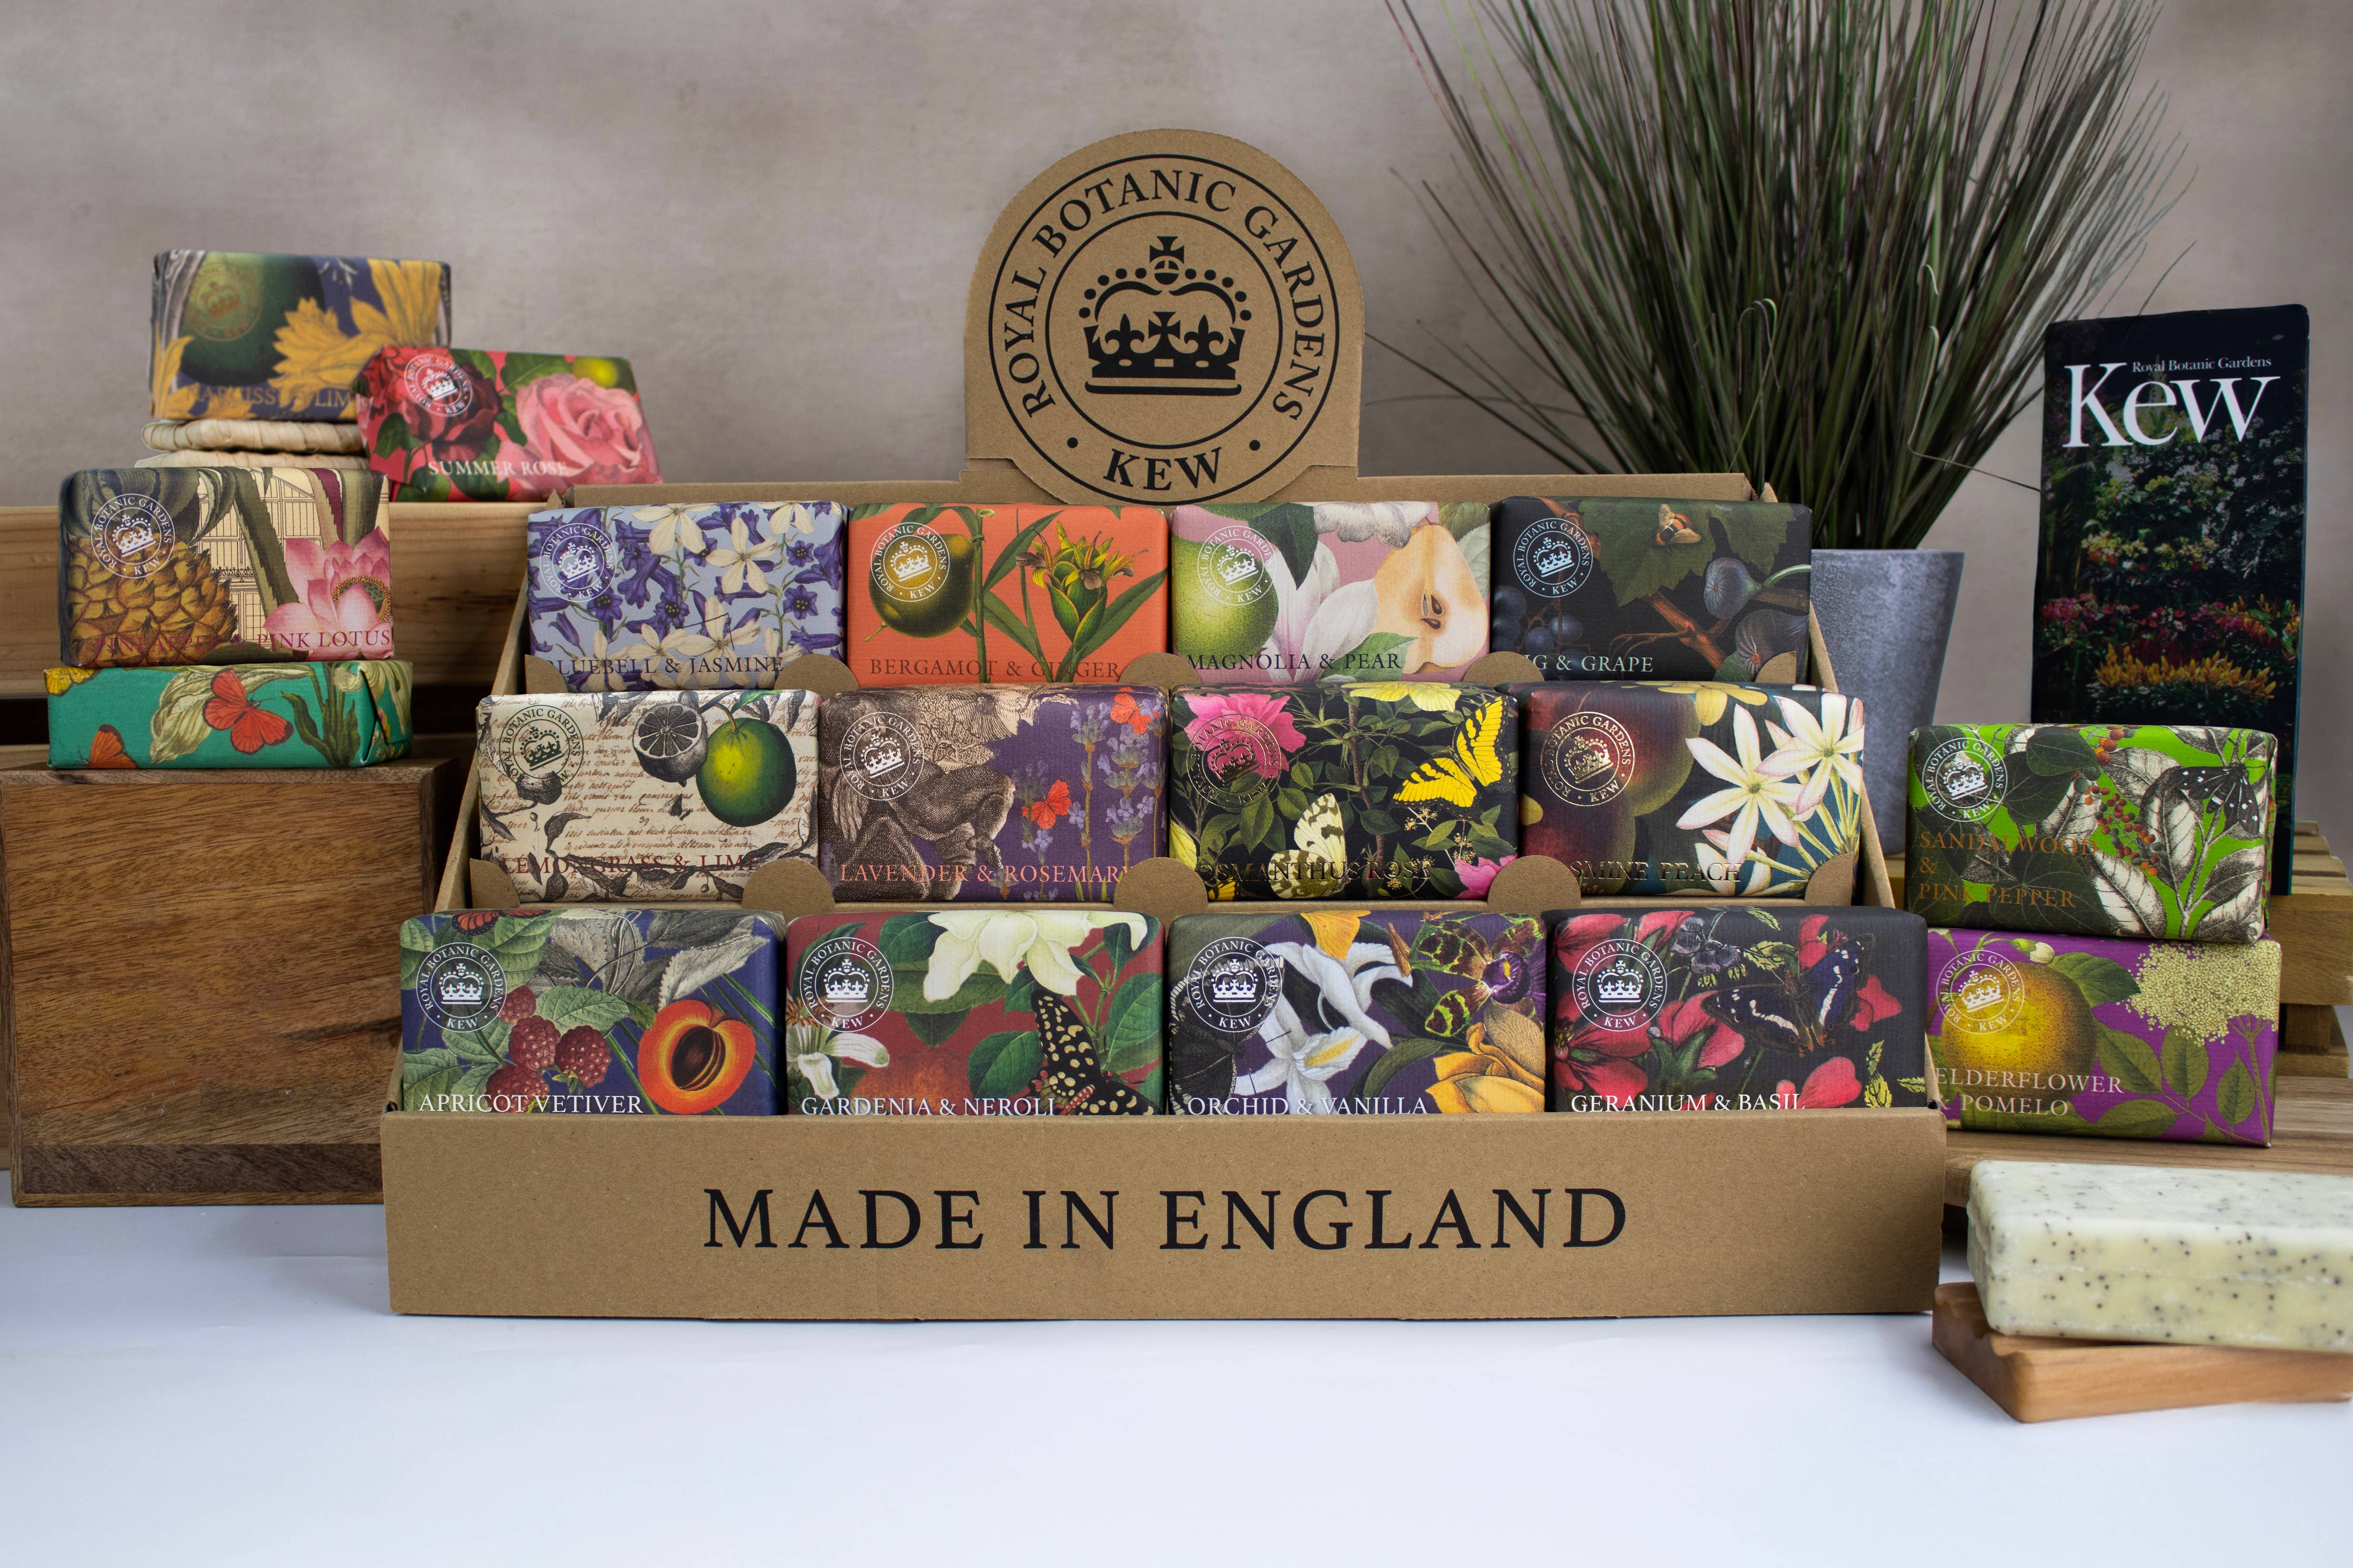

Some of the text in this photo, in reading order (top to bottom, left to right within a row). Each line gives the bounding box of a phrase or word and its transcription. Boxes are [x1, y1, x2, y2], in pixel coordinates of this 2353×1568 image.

[1004, 169, 1325, 421] ROYAL BOTANIC GARDENS
[2132, 356, 2272, 376] Royal Botanic Gardens
[314, 390, 356, 407] LIM
[2062, 361, 2281, 448] Kew
[428, 461, 567, 476] SUMMER ROSE
[1102, 446, 1222, 491] KEW
[95, 497, 172, 569] ROYAL BOTANIC GARDENS
[1201, 528, 1240, 561] BOTANIC
[134, 555, 161, 575] KEW
[543, 526, 614, 593] ROYAL BOTANIC GARDENS
[873, 525, 947, 592] ROYAL BOTANIC GARDENS
[1516, 521, 1590, 588] ROYAL BOTANIC GARDENS
[579, 581, 604, 599] KEW
[909, 581, 936, 599] KEW
[1236, 585, 1263, 603] KEW
[1552, 578, 1577, 595] KEW
[94, 630, 390, 654] PINEAPPLE & PINK LOTUS
[547, 656, 785, 675] LUEBELL & JASMINE
[870, 659, 1121, 678] BERGAMOT & GINGER
[1187, 653, 1402, 671] MAGNOLIA & PEAR
[1556, 655, 1573, 671] &
[1581, 655, 1653, 672] GRAPE
[504, 707, 543, 745] BOTANIC
[547, 710, 581, 756] GARDENS
[843, 715, 885, 751] BOTANIC
[888, 717, 921, 765] GARDENS
[1238, 718, 1279, 767] GARDENS
[1545, 715, 1590, 757] BOTANIC
[1592, 716, 1631, 765] GARDENS
[1926, 740, 2005, 811] ROYAL BOTANIC GARDENS
[882, 778, 909, 798] KEW
[1238, 782, 1268, 805] KEW
[1588, 779, 1620, 803] KEW
[1963, 801, 1990, 820] KEW
[1919, 830, 2098, 856] SANDALWOOD
[501, 854, 664, 875] LEMONGRASS
[673, 853, 691, 872] &
[699, 854, 760, 872] LIME
[841, 863, 969, 883] LAVENDER
[977, 864, 994, 882] &
[1197, 860, 1431, 883] OSMANTHUS ROSE
[1569, 860, 1741, 883] SMINE PEACH
[1919, 857, 1936, 874] &
[1918, 883, 2077, 908] PINK PEPPER
[419, 946, 504, 1010] ROYAL BOTANIC GARDENS
[805, 940, 890, 1009] ROYAL BOTANIC GARDENS
[1190, 940, 1279, 1009] ROYAL BOTANIC GARDENS
[1576, 943, 1663, 1010] ROYAL BOTANIC GARDENS
[1940, 953, 1985, 986] BOTANIC
[1987, 955, 2021, 1002] GARDENS
[446, 1017, 478, 1030] KEW
[830, 1016, 862, 1029] KEW
[1219, 1016, 1251, 1029] KEW
[1603, 1016, 1636, 1029] KEW
[1978, 1013, 2007, 1031] KEW
[1936, 1067, 2124, 1094] ELDERFLOWER
[418, 1094, 645, 1115] APRICOT VETIVER
[801, 1097, 1055, 1116] GARDENIA & NEROLI
[1188, 1097, 1428, 1116] ORCHID & VANILLA
[1571, 1093, 1806, 1113] GERANIUM & BASIL
[1960, 1094, 2069, 1117] POMELO
[703, 1186, 1628, 1251] MADE IN ENGLAND
